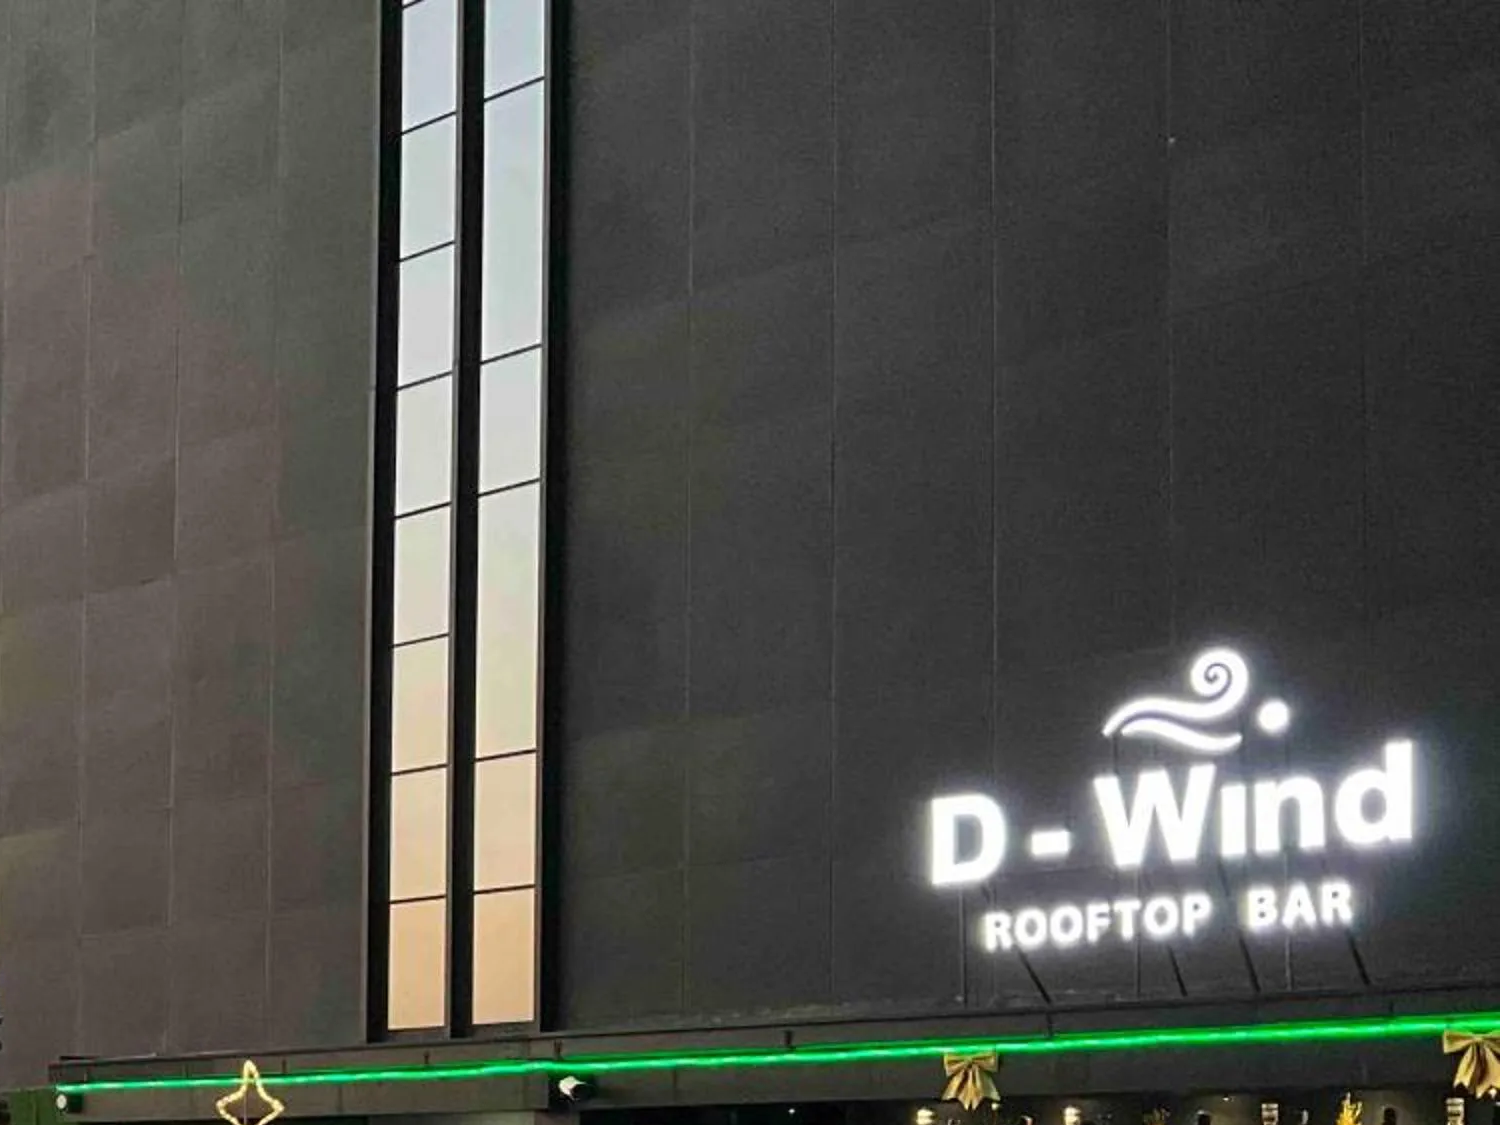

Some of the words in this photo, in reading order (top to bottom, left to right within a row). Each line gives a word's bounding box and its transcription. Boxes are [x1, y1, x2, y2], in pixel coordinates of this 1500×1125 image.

[1092, 700, 1415, 870] Wind
[981, 891, 1213, 952] ROOFTOP
[1244, 880, 1354, 933] BAR
